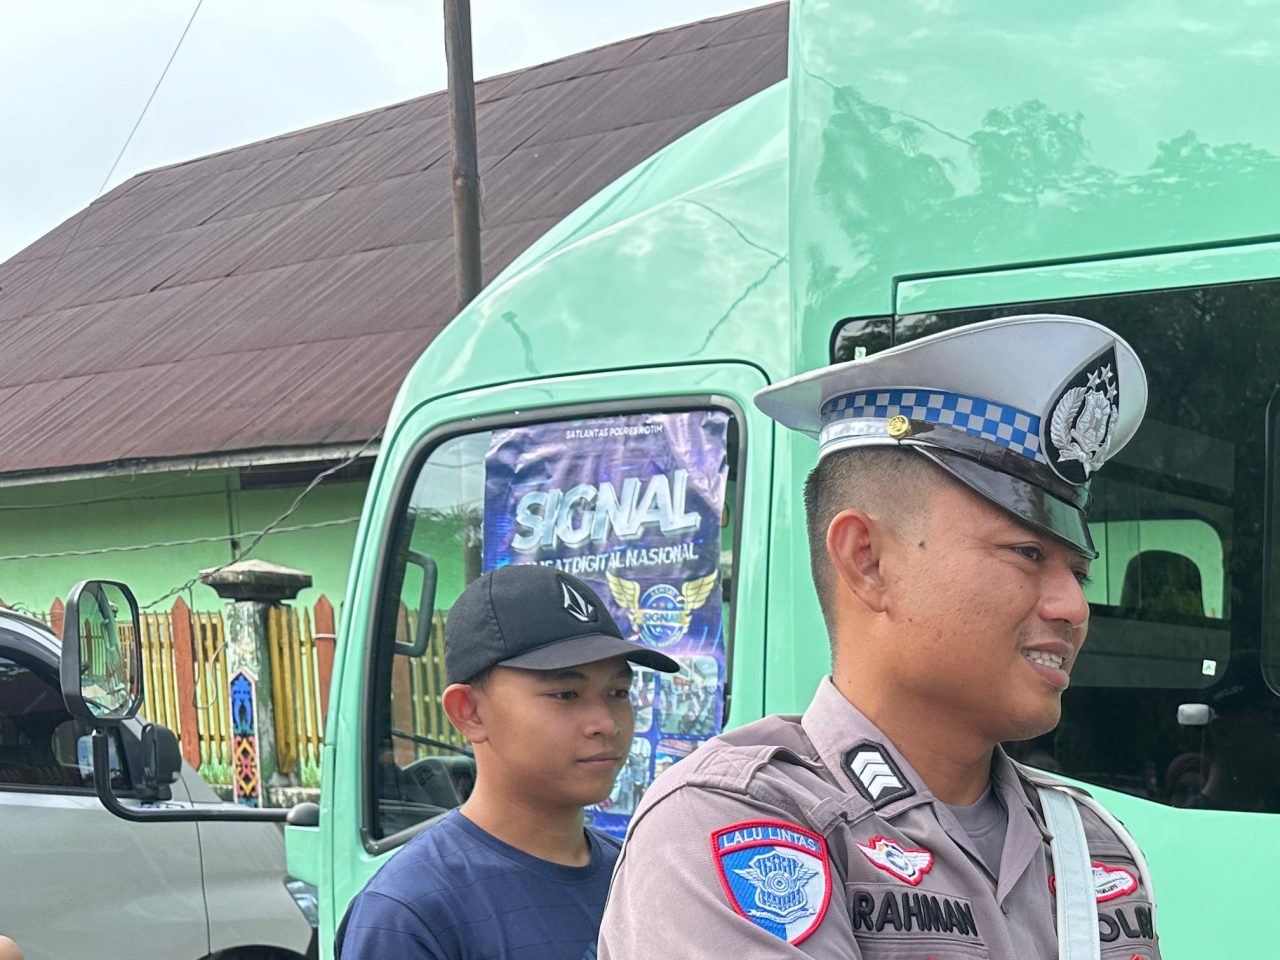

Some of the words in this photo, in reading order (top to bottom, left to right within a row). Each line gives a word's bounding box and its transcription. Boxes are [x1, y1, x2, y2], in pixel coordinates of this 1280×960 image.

[511, 469, 701, 551] SIGNAL
[572, 553, 625, 574] DIGITAL
[625, 542, 699, 567] NASIONAL
[723, 827, 762, 848] LALU
[768, 827, 816, 852] LINTAS
[852, 890, 979, 938] RAHMAN
[1097, 906, 1154, 943] OLRI
